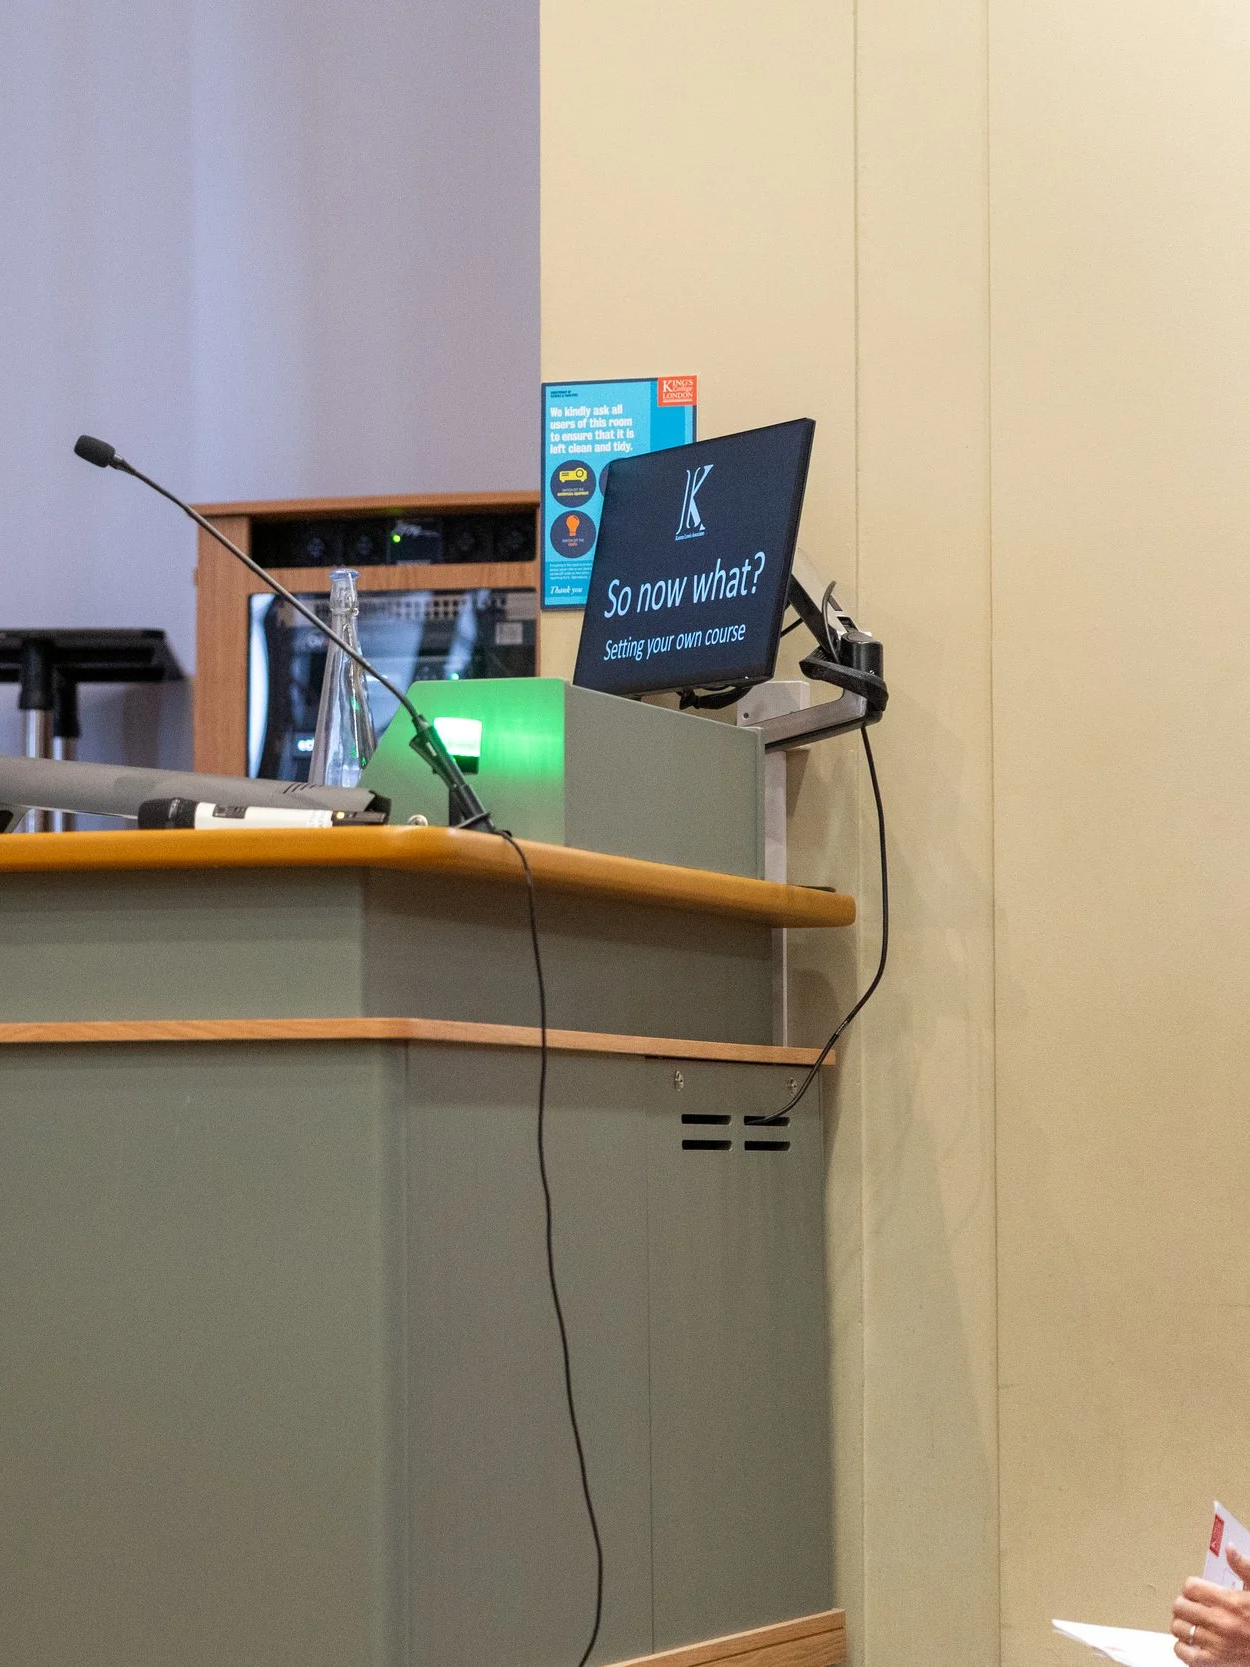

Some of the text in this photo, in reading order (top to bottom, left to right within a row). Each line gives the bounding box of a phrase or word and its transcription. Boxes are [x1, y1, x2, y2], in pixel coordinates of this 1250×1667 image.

[662, 379, 694, 393] KING'S
[550, 404, 623, 418] We kindly ask all
[550, 417, 633, 429] users of this room
[550, 428, 635, 442] to ensure that it is
[550, 440, 634, 454] left clean and tidy.
[550, 585, 583, 595] Thank you
[603, 551, 766, 618] So now what?
[603, 623, 746, 661] Setting your own course
